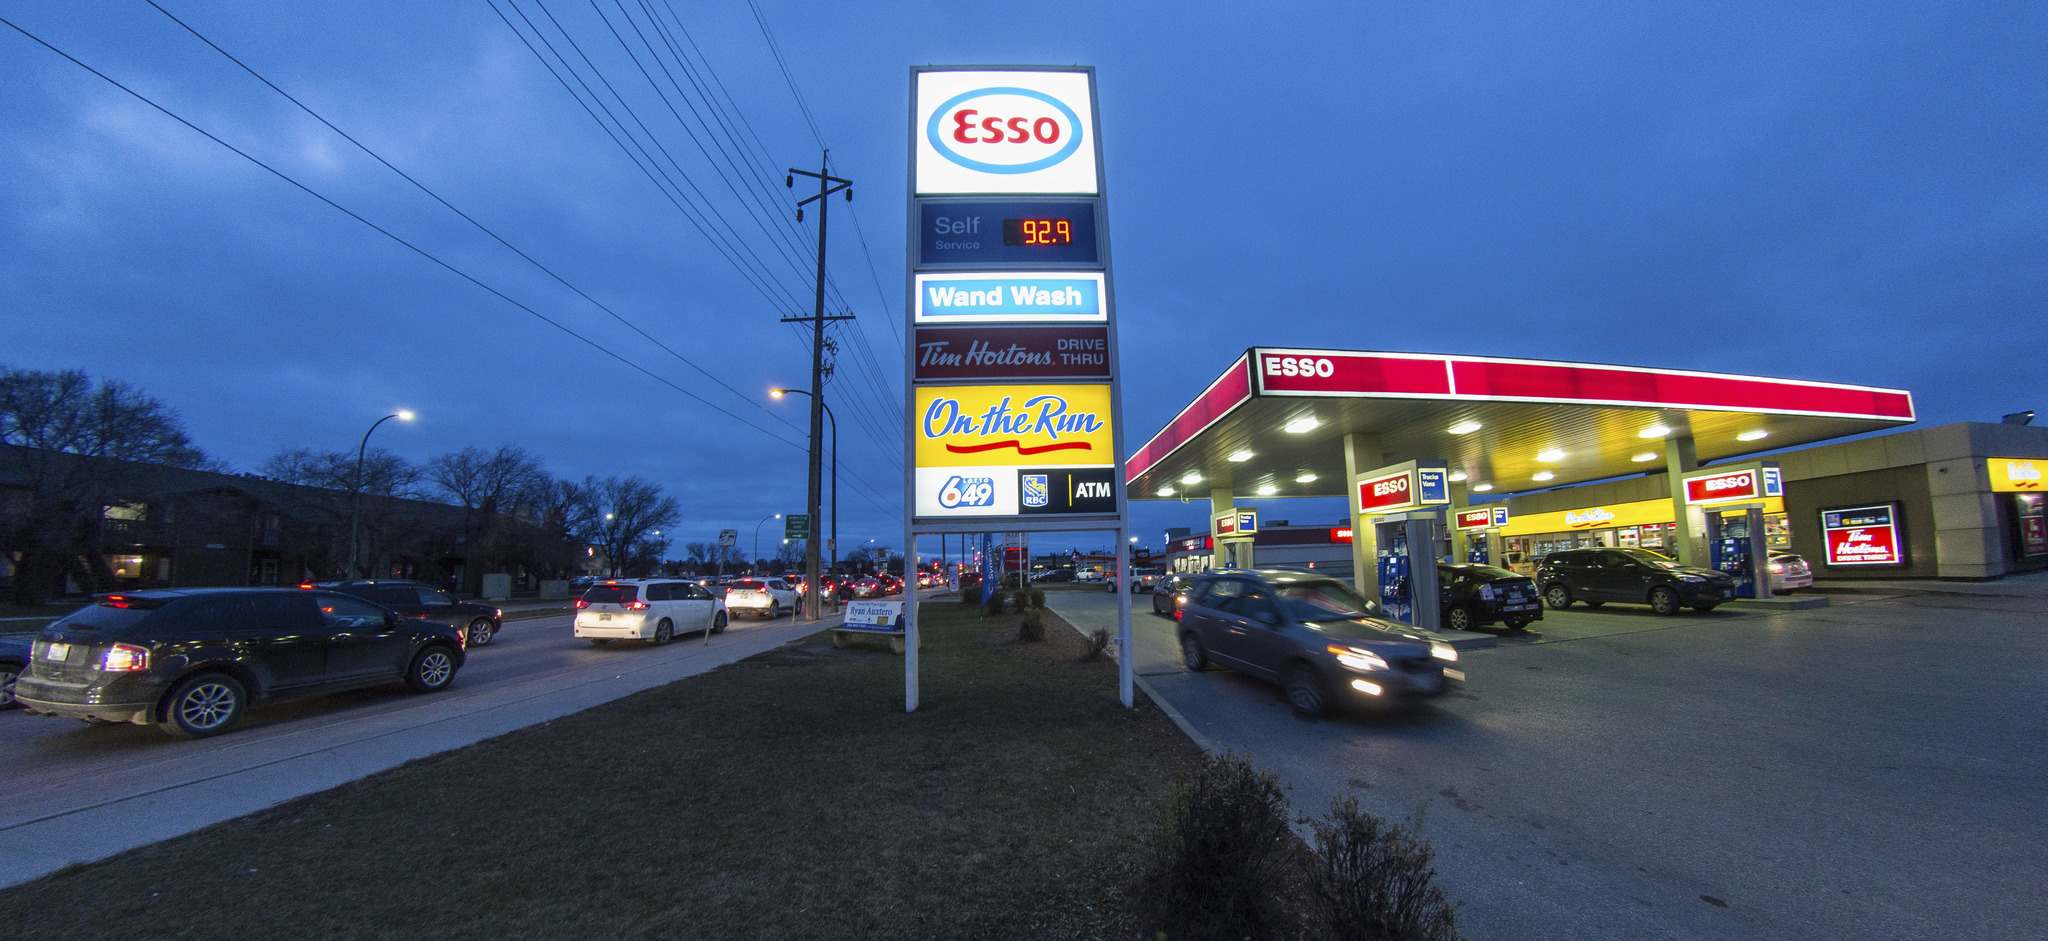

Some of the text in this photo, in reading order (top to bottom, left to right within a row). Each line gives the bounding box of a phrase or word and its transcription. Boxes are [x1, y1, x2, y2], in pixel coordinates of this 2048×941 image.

[953, 109, 1060, 144] Esso
[935, 216, 981, 235] Self
[1022, 220, 1070, 244] 92.9
[935, 240, 980, 250] Service
[929, 285, 1082, 307] Wand Wash
[919, 338, 1052, 367] Tim Hortons
[1057, 338, 1105, 351] DRIVE
[1060, 353, 1104, 365] THRU
[1265, 357, 1334, 378] ESSO
[924, 394, 1104, 440] On the Run
[1075, 482, 1111, 498] ATM
[1374, 478, 1407, 497] ESSO
[1705, 475, 1750, 491] ESSO
[1025, 496, 1045, 505] RBC
[1846, 529, 1873, 542] Tim
[850, 606, 866, 617] Ryan
